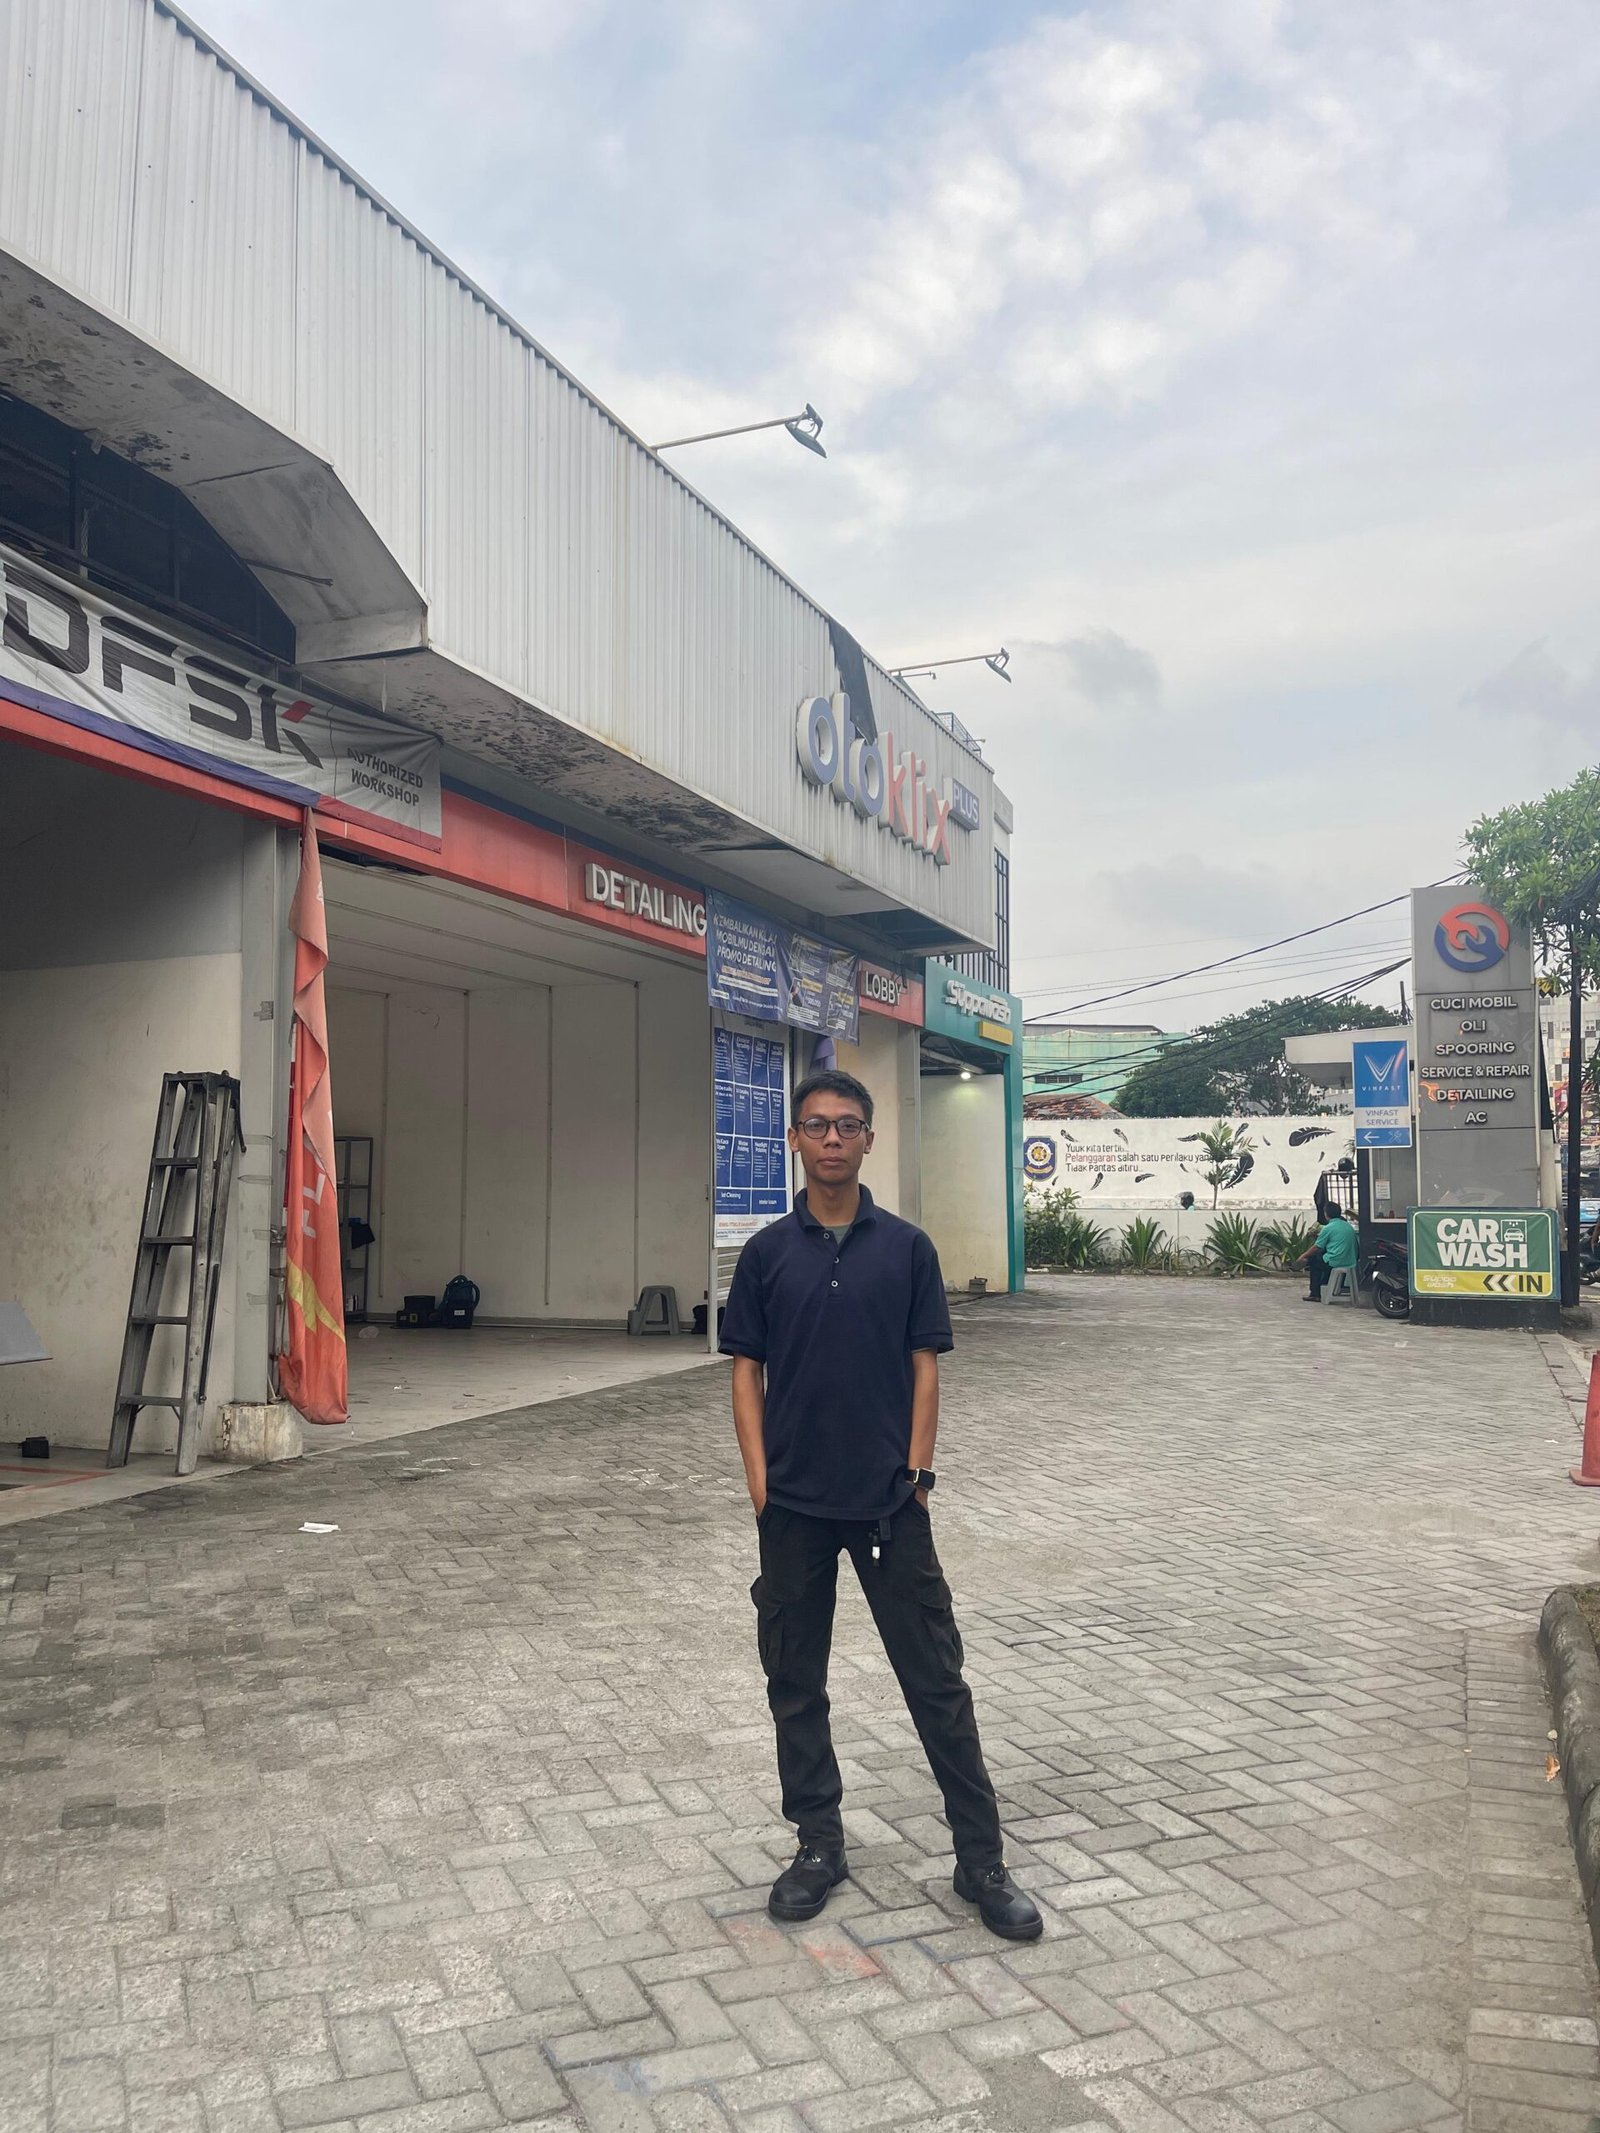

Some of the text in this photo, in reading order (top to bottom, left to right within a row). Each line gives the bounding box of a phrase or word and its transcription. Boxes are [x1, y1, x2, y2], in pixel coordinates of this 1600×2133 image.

[2, 562, 324, 770] DFSK
[346, 747, 424, 789] AUTHORIZED
[797, 691, 979, 866] otoklix PLUS
[351, 768, 420, 806] WORKSHOP
[586, 863, 707, 937] DETAILING
[717, 945, 742, 963] PROMO
[865, 971, 901, 1006] LOBBY
[1431, 996, 1517, 1010] CUCI MOBIL
[1461, 1020, 1486, 1031] OLI
[1436, 1042, 1515, 1055] SPOORING
[1421, 1064, 1530, 1078] SERVICE & REPAIR
[1437, 1088, 1515, 1101] DETAILING
[1365, 1109, 1399, 1117] VINFAST
[1465, 1112, 1487, 1123] AC
[1366, 1118, 1399, 1126] SERVICE
[1065, 1153, 1116, 1163] Pelanggaran
[1117, 1153, 1139, 1161] salah
[1141, 1154, 1159, 1162] satu
[1065, 1163, 1087, 1172] Tidak
[1436, 1218, 1500, 1243] CAR
[1437, 1242, 1528, 1268] WASH
[1519, 1275, 1543, 1293] IN
